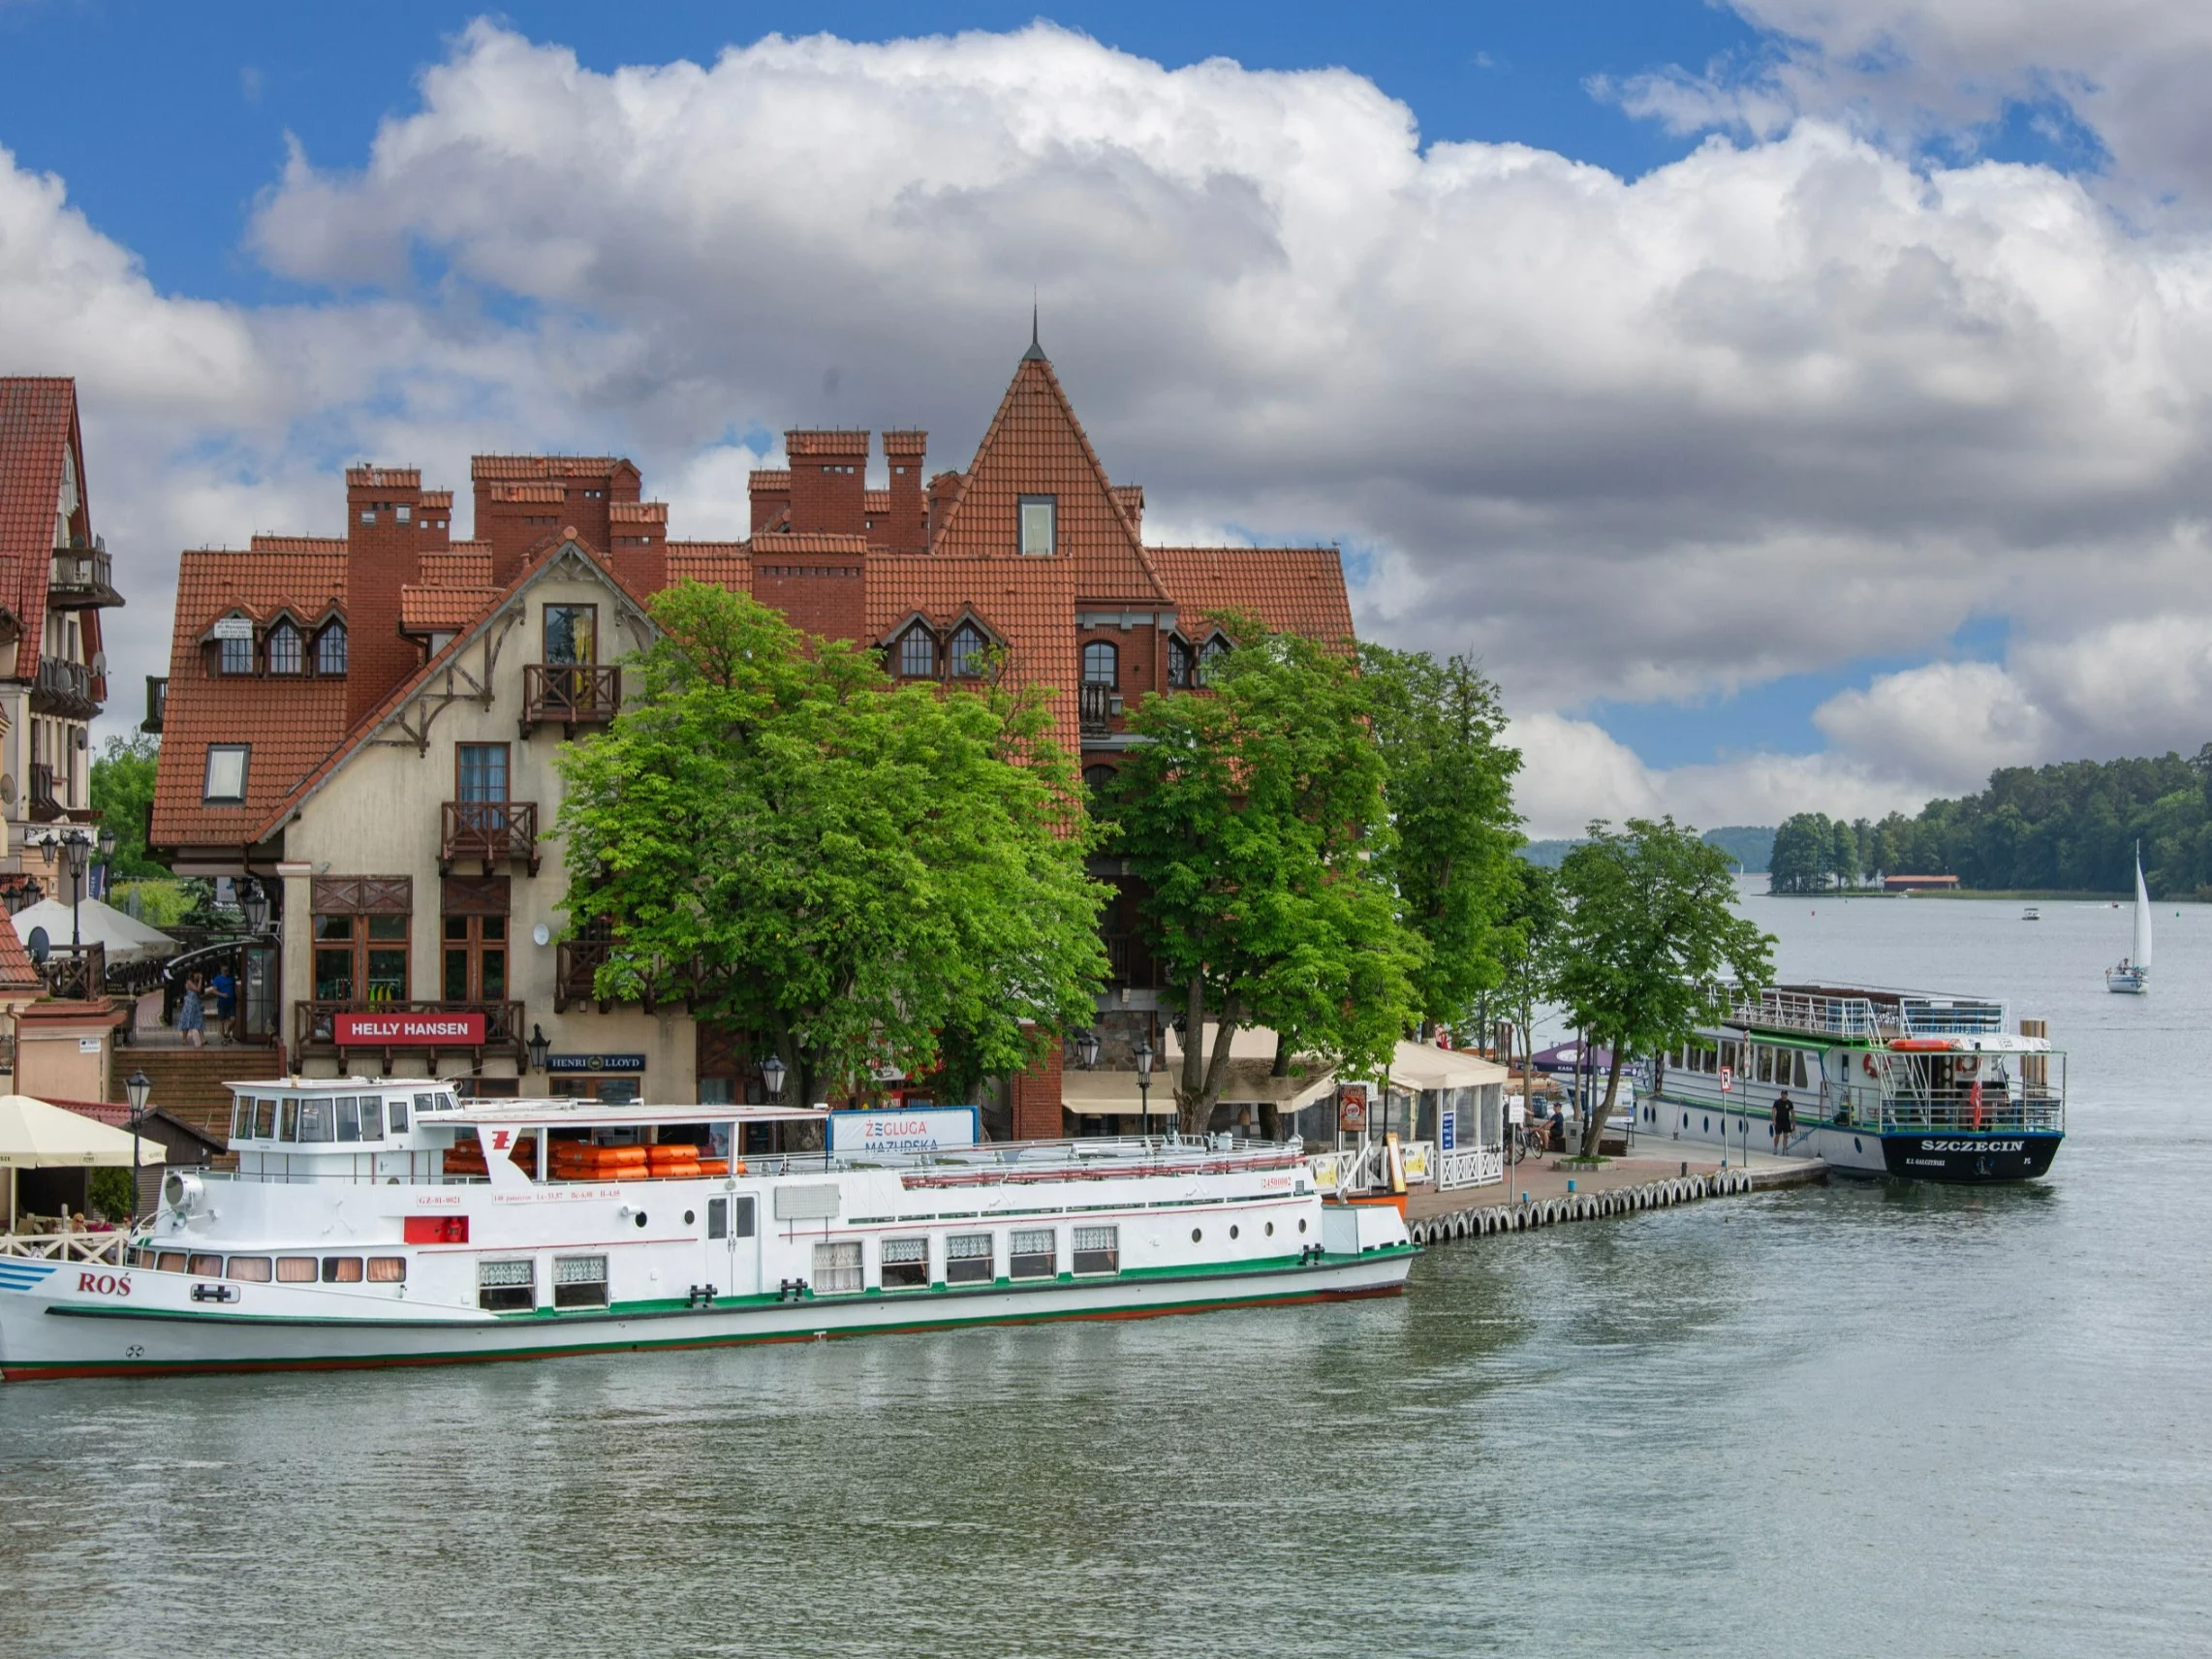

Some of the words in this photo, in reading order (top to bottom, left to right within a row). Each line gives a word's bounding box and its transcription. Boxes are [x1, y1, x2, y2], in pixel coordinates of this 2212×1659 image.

[352, 1023, 399, 1035] HELLY
[404, 1023, 468, 1035] HANSEN
[552, 1058, 586, 1067] HENRI
[605, 1058, 639, 1067] LLOYD
[1921, 1141, 2025, 1152] SZCZECIN
[77, 1271, 132, 1297] ROŚ
